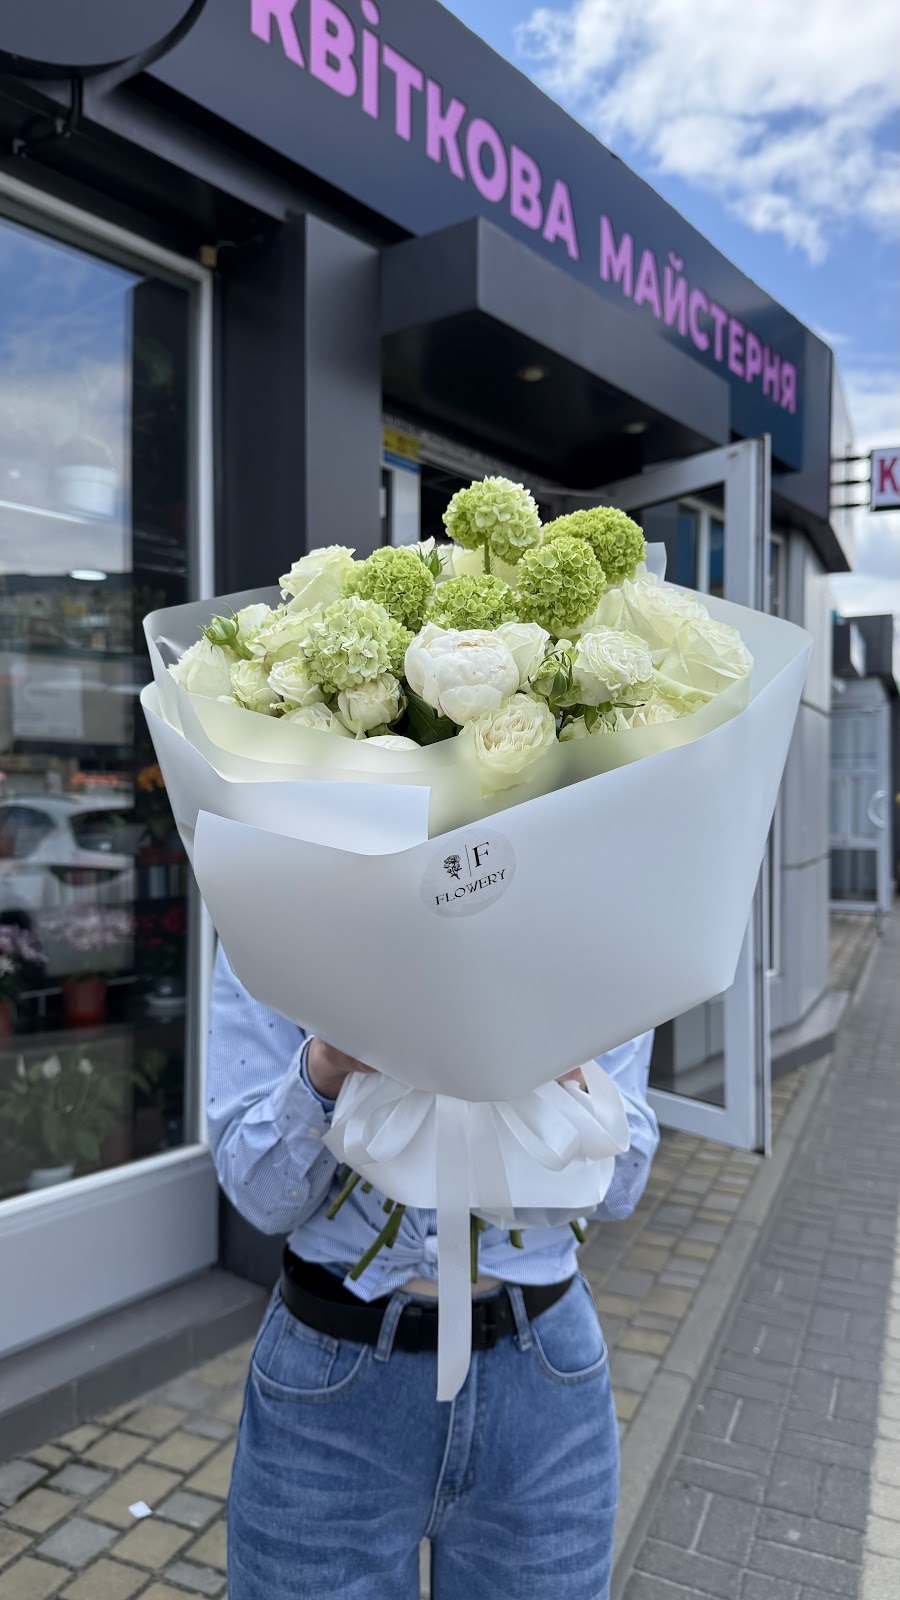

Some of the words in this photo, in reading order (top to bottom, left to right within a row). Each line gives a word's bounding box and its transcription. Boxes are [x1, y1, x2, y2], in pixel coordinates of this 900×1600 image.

[600, 214, 797, 414] МАЙСТЕРНЯ
[472, 841, 490, 868] F
[435, 868, 506, 906] FLOWERY
